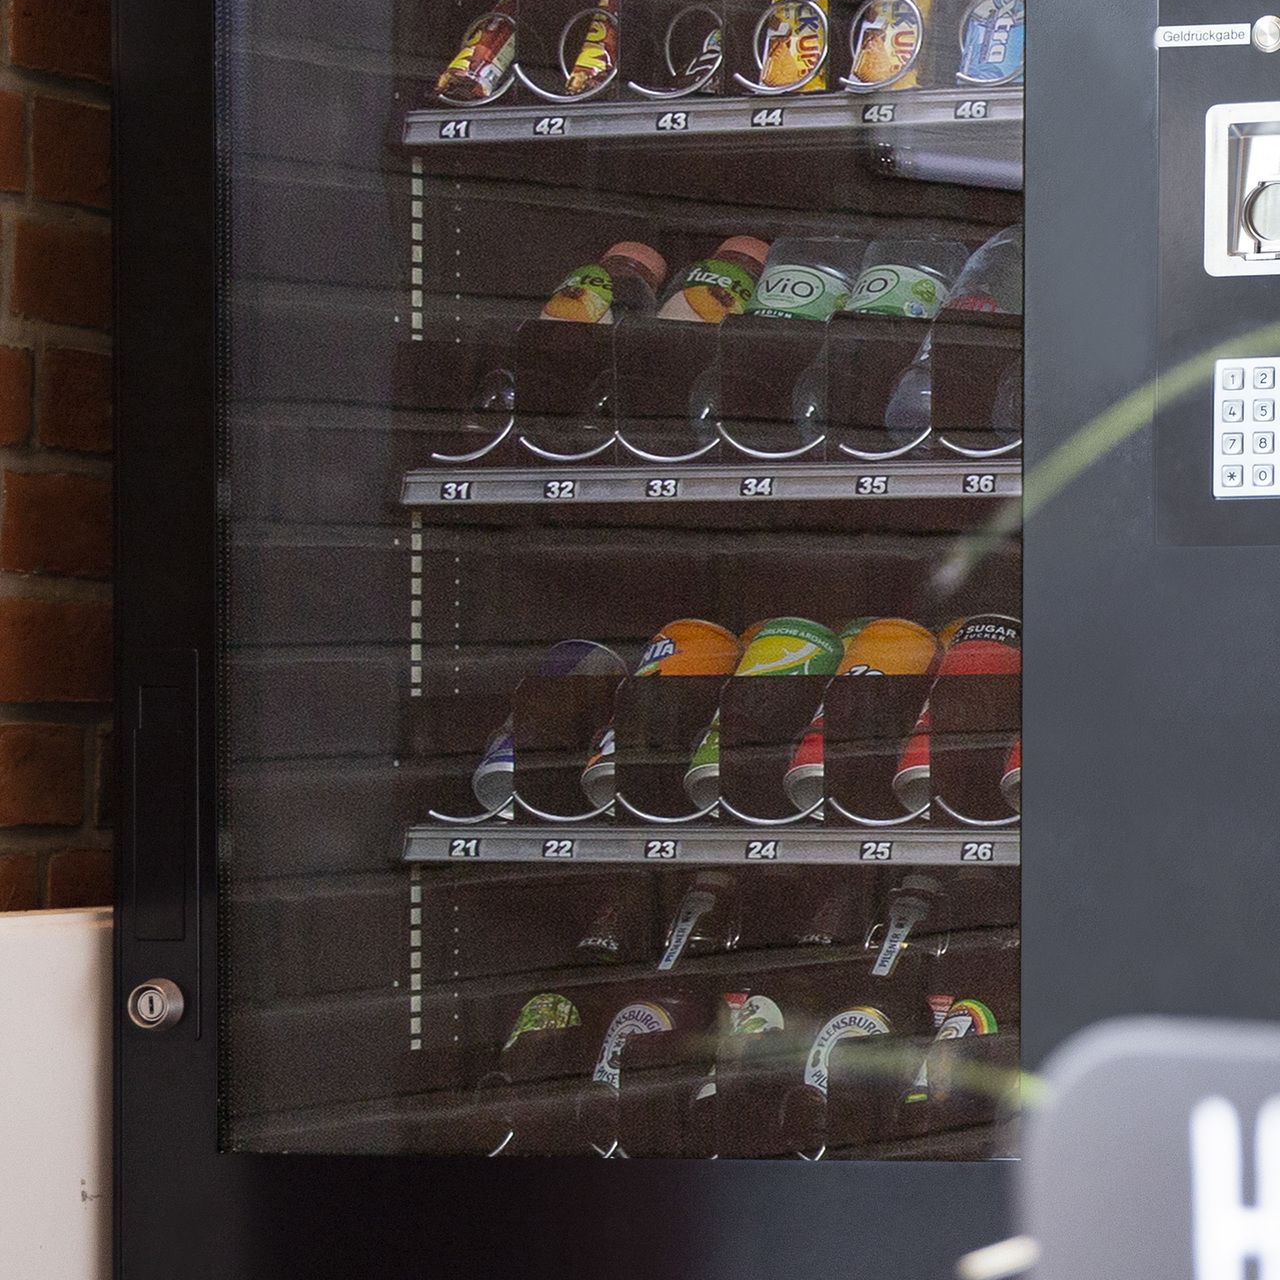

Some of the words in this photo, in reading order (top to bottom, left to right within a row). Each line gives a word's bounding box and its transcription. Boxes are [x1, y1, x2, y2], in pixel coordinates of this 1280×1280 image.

[440, 122, 469, 138] 41
[535, 118, 563, 134] 42
[657, 113, 687, 130] 43
[753, 108, 783, 125] 44
[864, 105, 894, 121] 45
[956, 101, 986, 118] 46
[687, 268, 752, 301] fuzete
[1259, 373, 1268, 384] 2
[1228, 406, 1236, 417] 4
[1260, 405, 1268, 417] 5
[1228, 438, 1237, 449] 7
[1258, 437, 1268, 449] 8
[443, 482, 469, 499] 31
[546, 481, 575, 498] 32
[648, 480, 677, 496] 33
[743, 478, 772, 495] 34
[858, 477, 887, 493] 35
[965, 475, 995, 492] 36
[966, 624, 1017, 639] SUGAR
[451, 839, 478, 857] 21
[545, 840, 573, 857] 22
[647, 841, 675, 858] 23
[748, 841, 777, 858] 24
[862, 842, 891, 859] 25
[963, 843, 992, 860] 26
